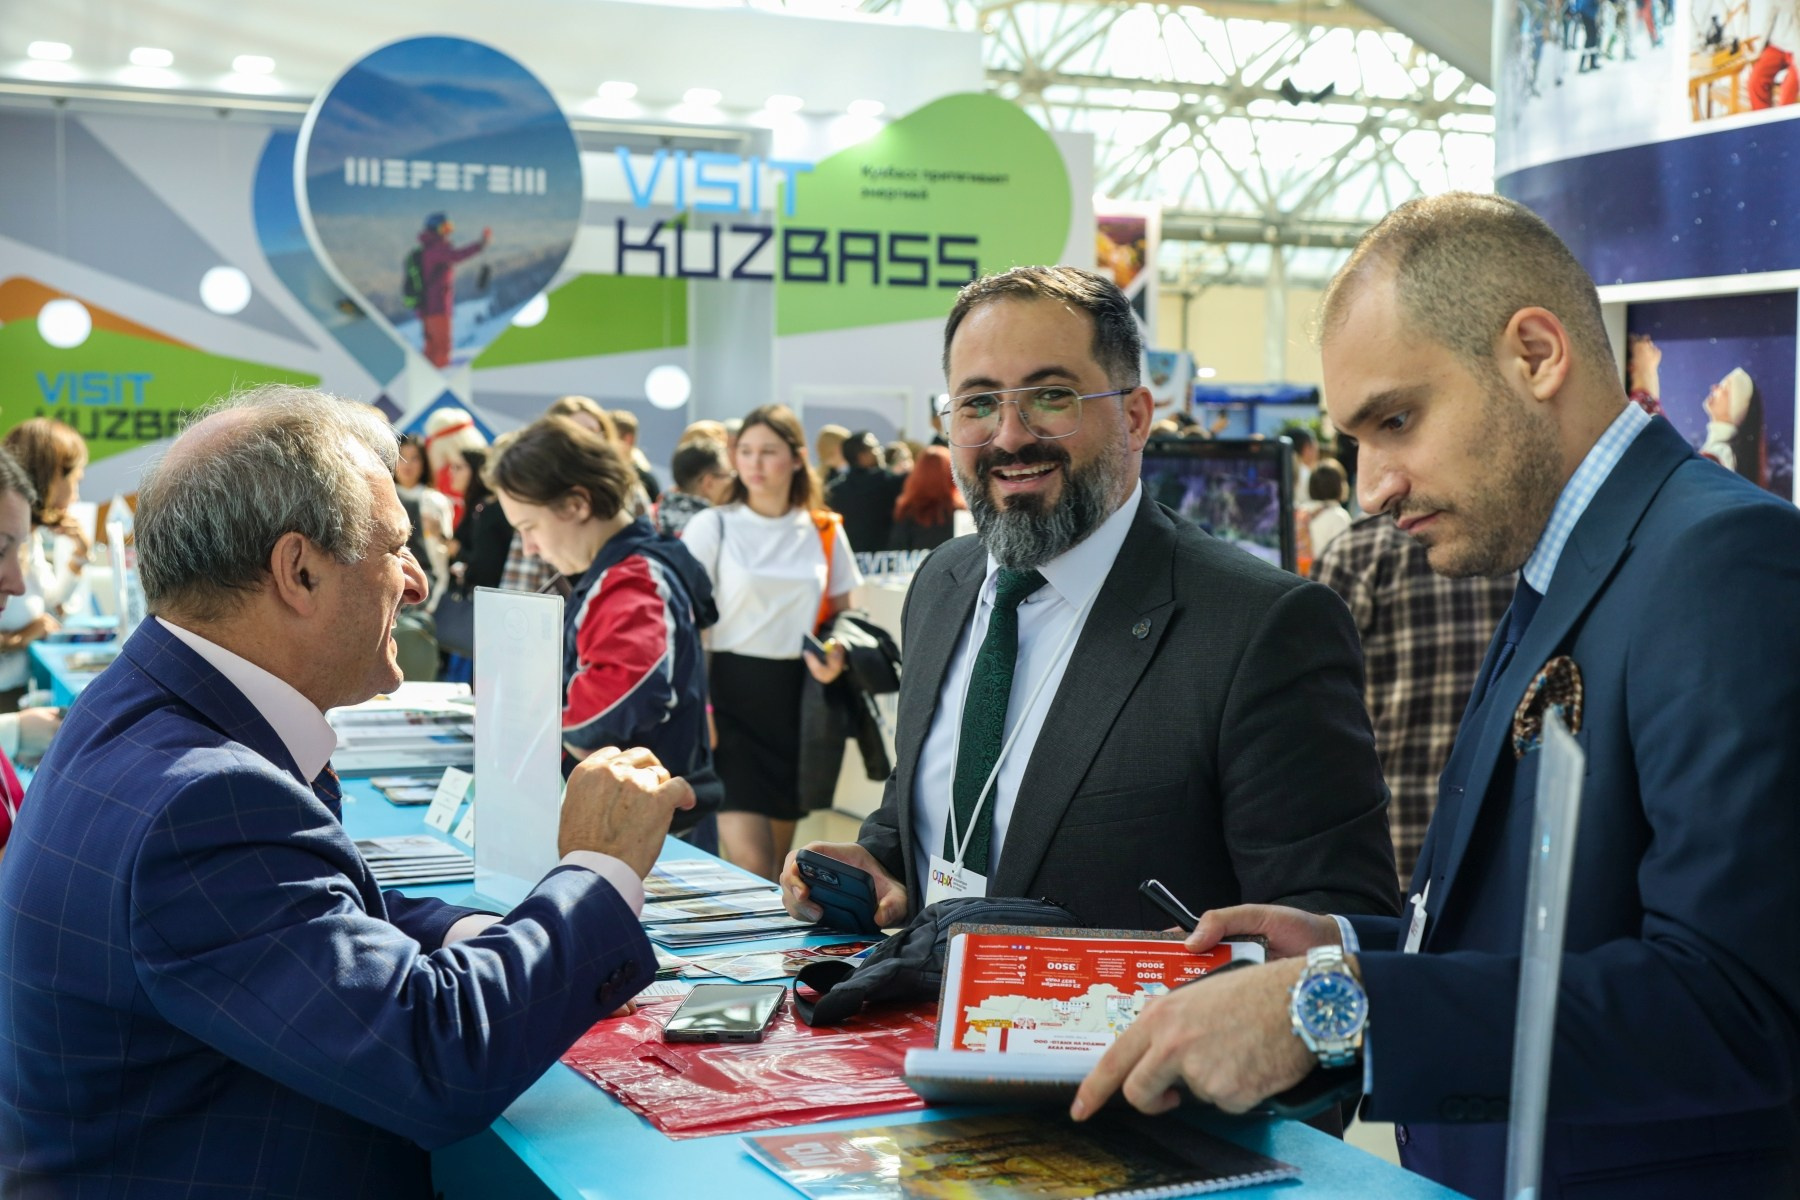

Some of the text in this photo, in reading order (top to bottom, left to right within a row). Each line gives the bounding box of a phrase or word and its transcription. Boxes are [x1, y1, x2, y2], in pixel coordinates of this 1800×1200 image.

[613, 145, 815, 217] VISIT
[615, 217, 980, 288] KUZBASS
[35, 370, 154, 406] VISIT
[1047, 962, 1076, 971] 3500
[1137, 971, 1163, 979] 5000
[1183, 967, 1208, 975] 70%
